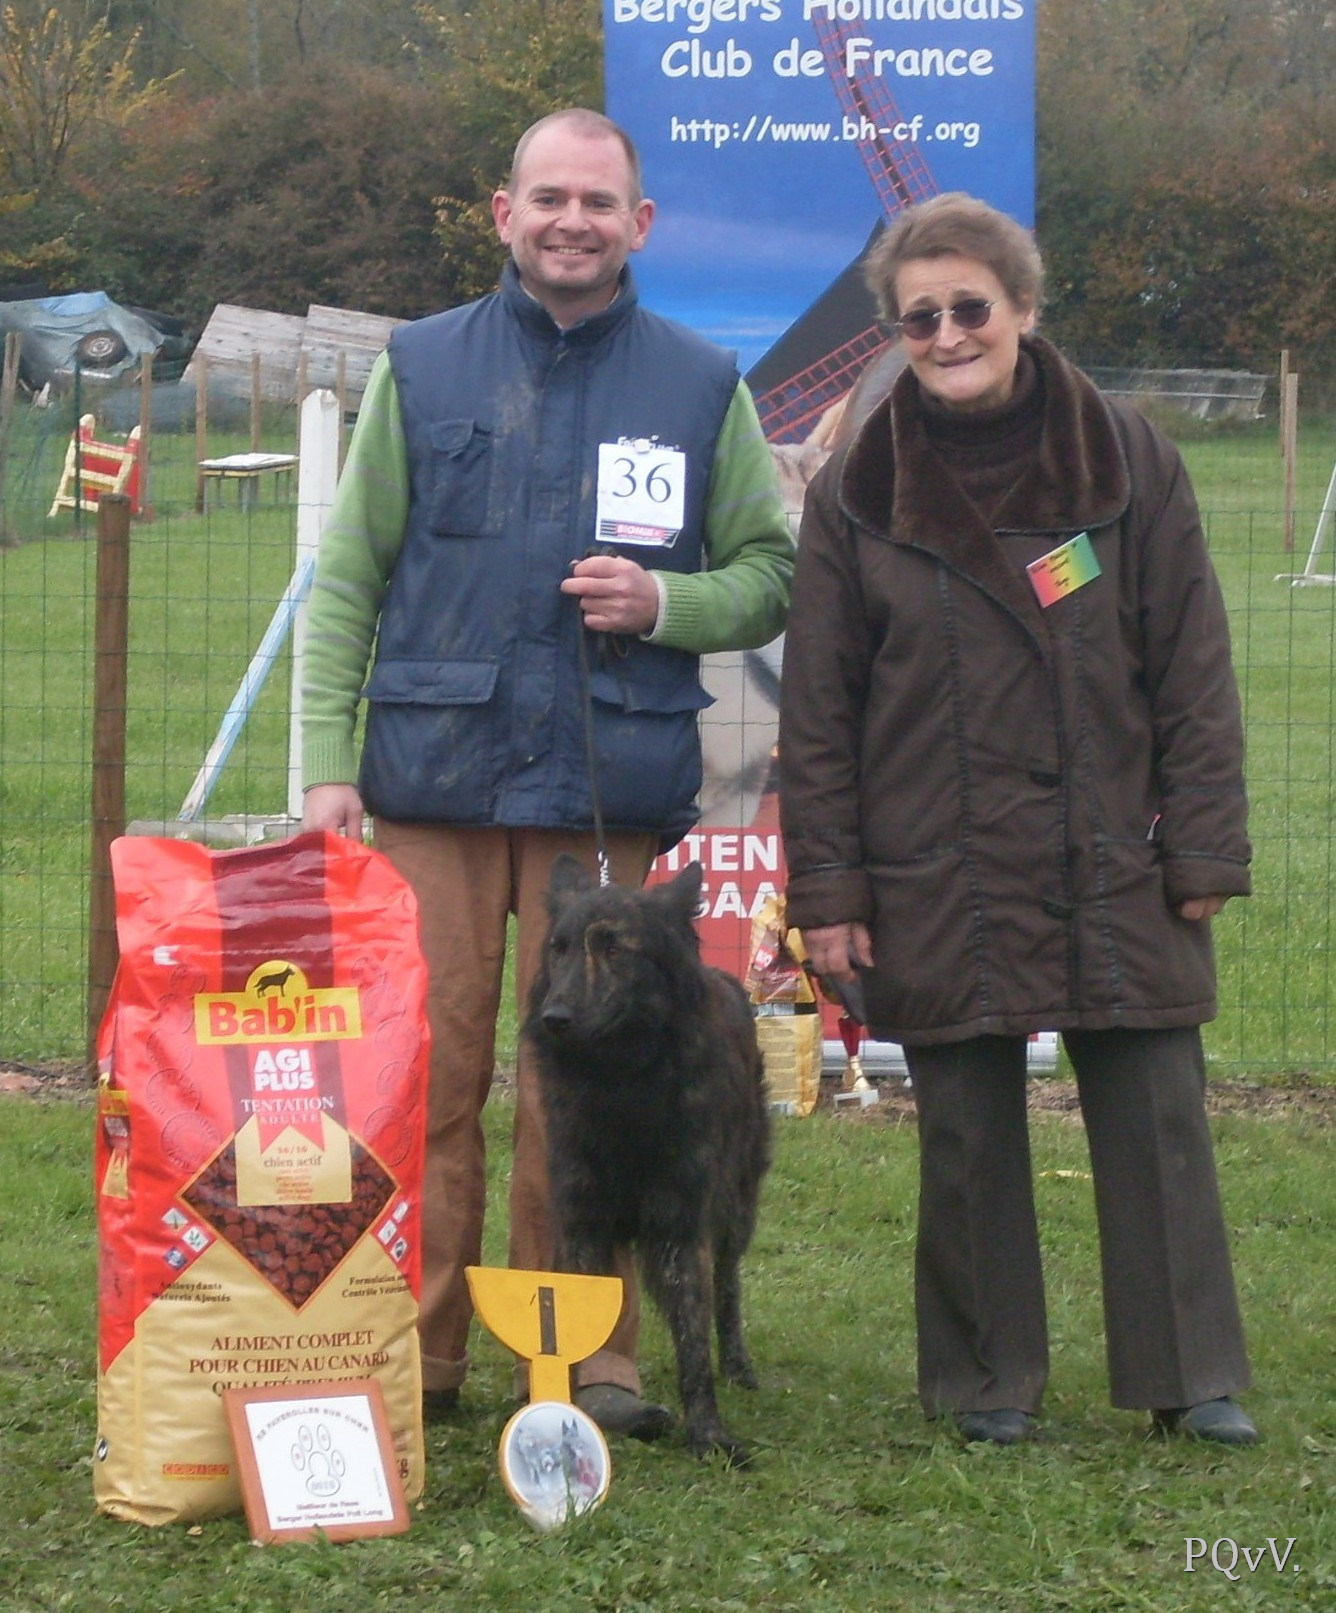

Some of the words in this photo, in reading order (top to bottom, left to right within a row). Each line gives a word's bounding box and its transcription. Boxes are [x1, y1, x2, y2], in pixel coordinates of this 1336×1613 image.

[613, 0, 781, 33] Bergers
[661, 37, 752, 79] Club
[772, 37, 825, 78] de
[845, 37, 994, 79] France
[670, 115, 981, 149] http://www.bh-cf.org
[612, 457, 672, 503] 36
[208, 996, 347, 1037] Bab'in
[254, 1048, 311, 1072] AGI
[254, 1071, 315, 1092] PLUS
[240, 1096, 335, 1113] TENTATION
[263, 1155, 294, 1168] chien
[296, 1154, 323, 1167] actif
[211, 1334, 296, 1352] ALIMENT
[296, 1330, 376, 1348] COMPLET
[189, 1357, 240, 1375] POUR
[242, 1355, 300, 1373] CHIEN
[302, 1353, 328, 1371] AU
[327, 1350, 390, 1370] CANARD
